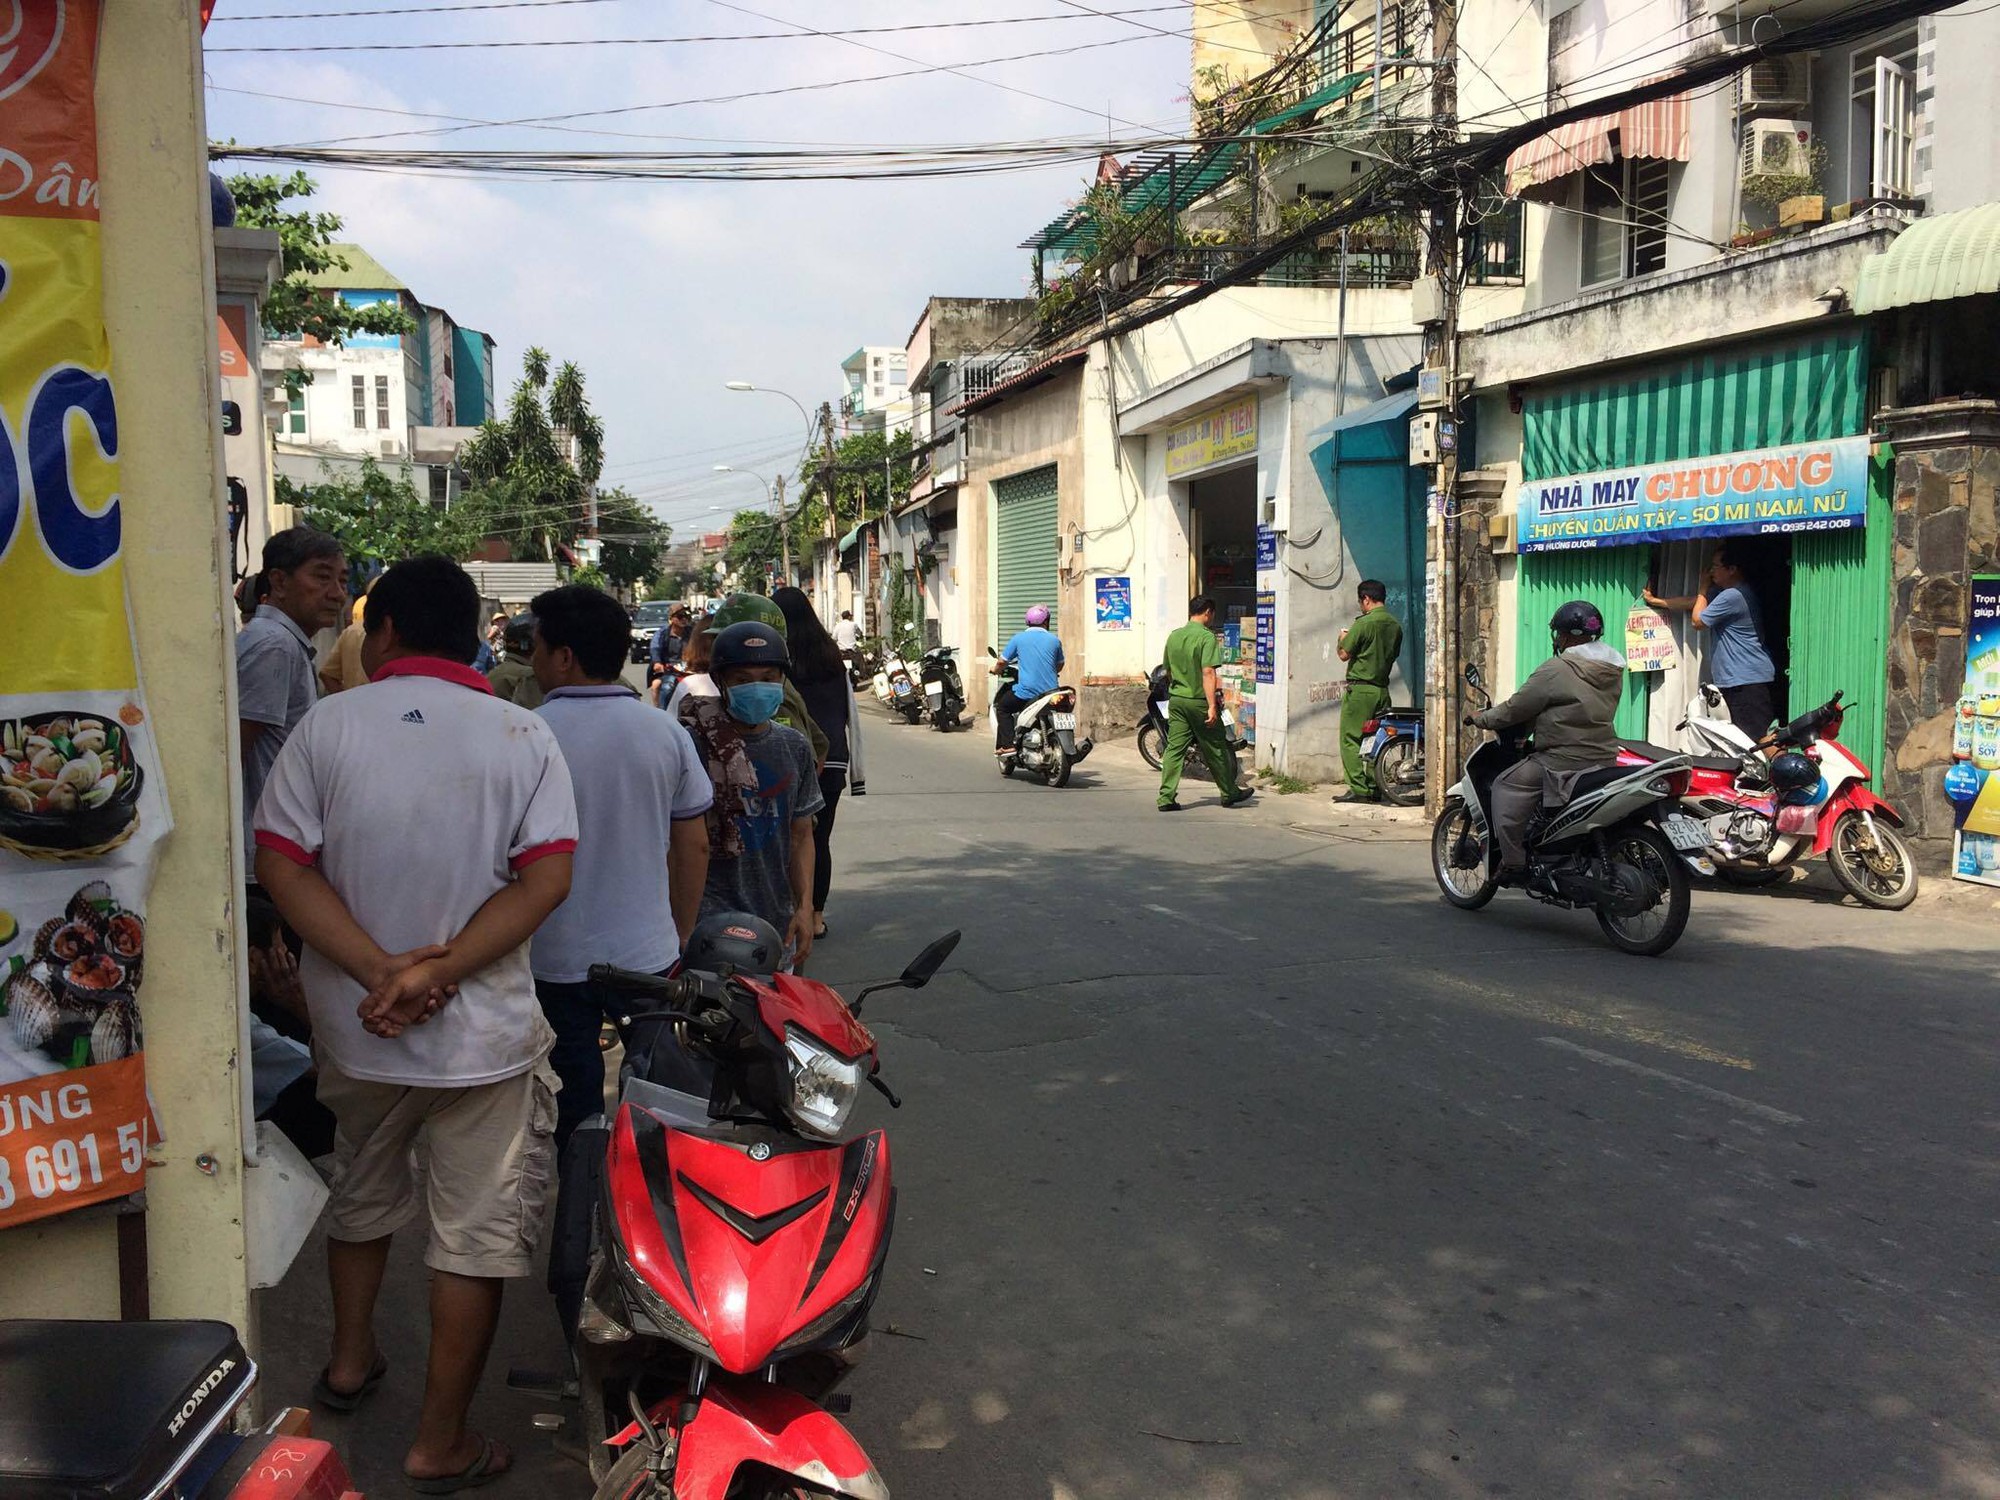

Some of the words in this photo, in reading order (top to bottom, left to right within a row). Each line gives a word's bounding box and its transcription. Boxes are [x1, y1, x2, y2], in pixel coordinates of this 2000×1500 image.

[0, 362, 121, 575] C
[1540, 482, 1582, 511] NHÀ
[1591, 476, 1639, 505] MAY
[1645, 452, 1833, 503] CHƯƠNG
[1725, 503, 1750, 520] MI
[1813, 490, 1847, 513] NỮ
[1806, 520, 1828, 531] 242
[1829, 519, 1851, 529] 008
[1975, 594, 1996, 605] Trọn
[1643, 629, 1656, 640] 5K
[1643, 660, 1661, 670] 10K
[1978, 746, 1997, 757] SOY
[25, 1133, 103, 1199] 691
[167, 1359, 236, 1438] HONDA
